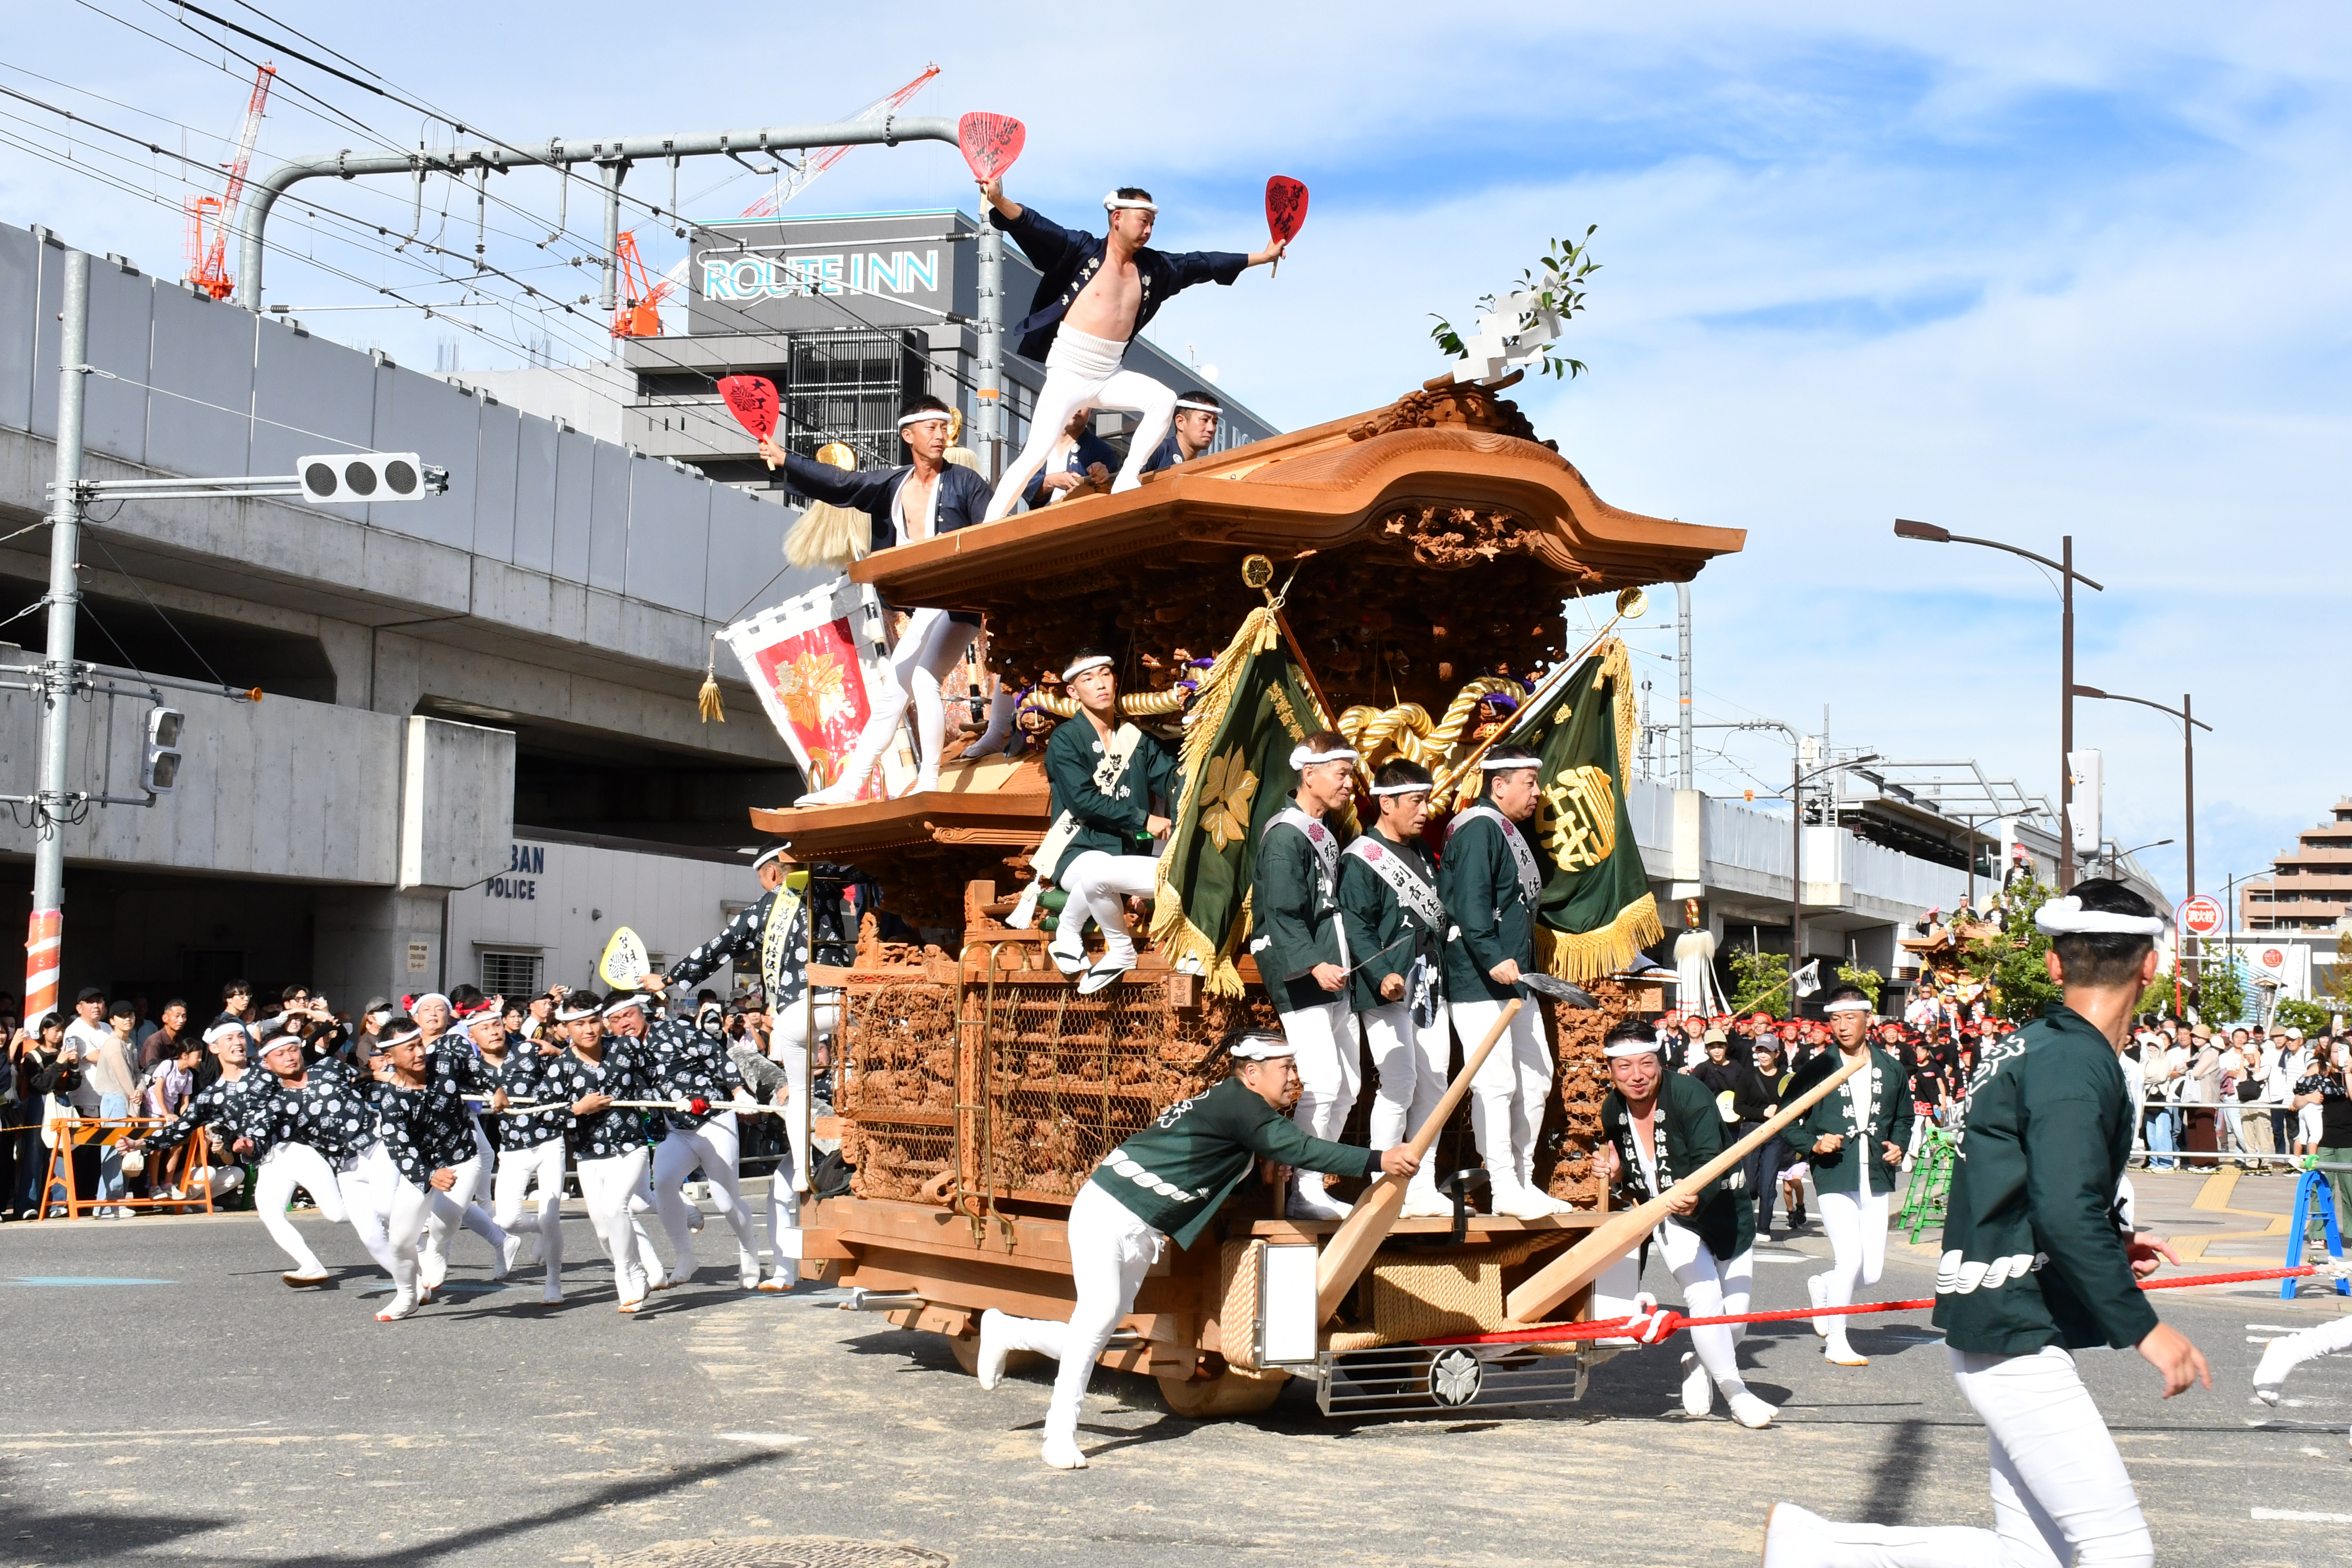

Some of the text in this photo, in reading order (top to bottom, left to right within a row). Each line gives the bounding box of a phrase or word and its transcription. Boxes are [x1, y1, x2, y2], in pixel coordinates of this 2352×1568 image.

[703, 250, 938, 301] ROUTE INN
[749, 379, 771, 432] 大工方
[486, 878, 535, 899] POLICE
[1391, 864, 1446, 932] 副責任者
[2187, 910, 2215, 923] 消火栓
[1622, 1131, 1645, 1189] 拾伍人組
[1654, 1128, 1675, 1188] 拾伍人組
